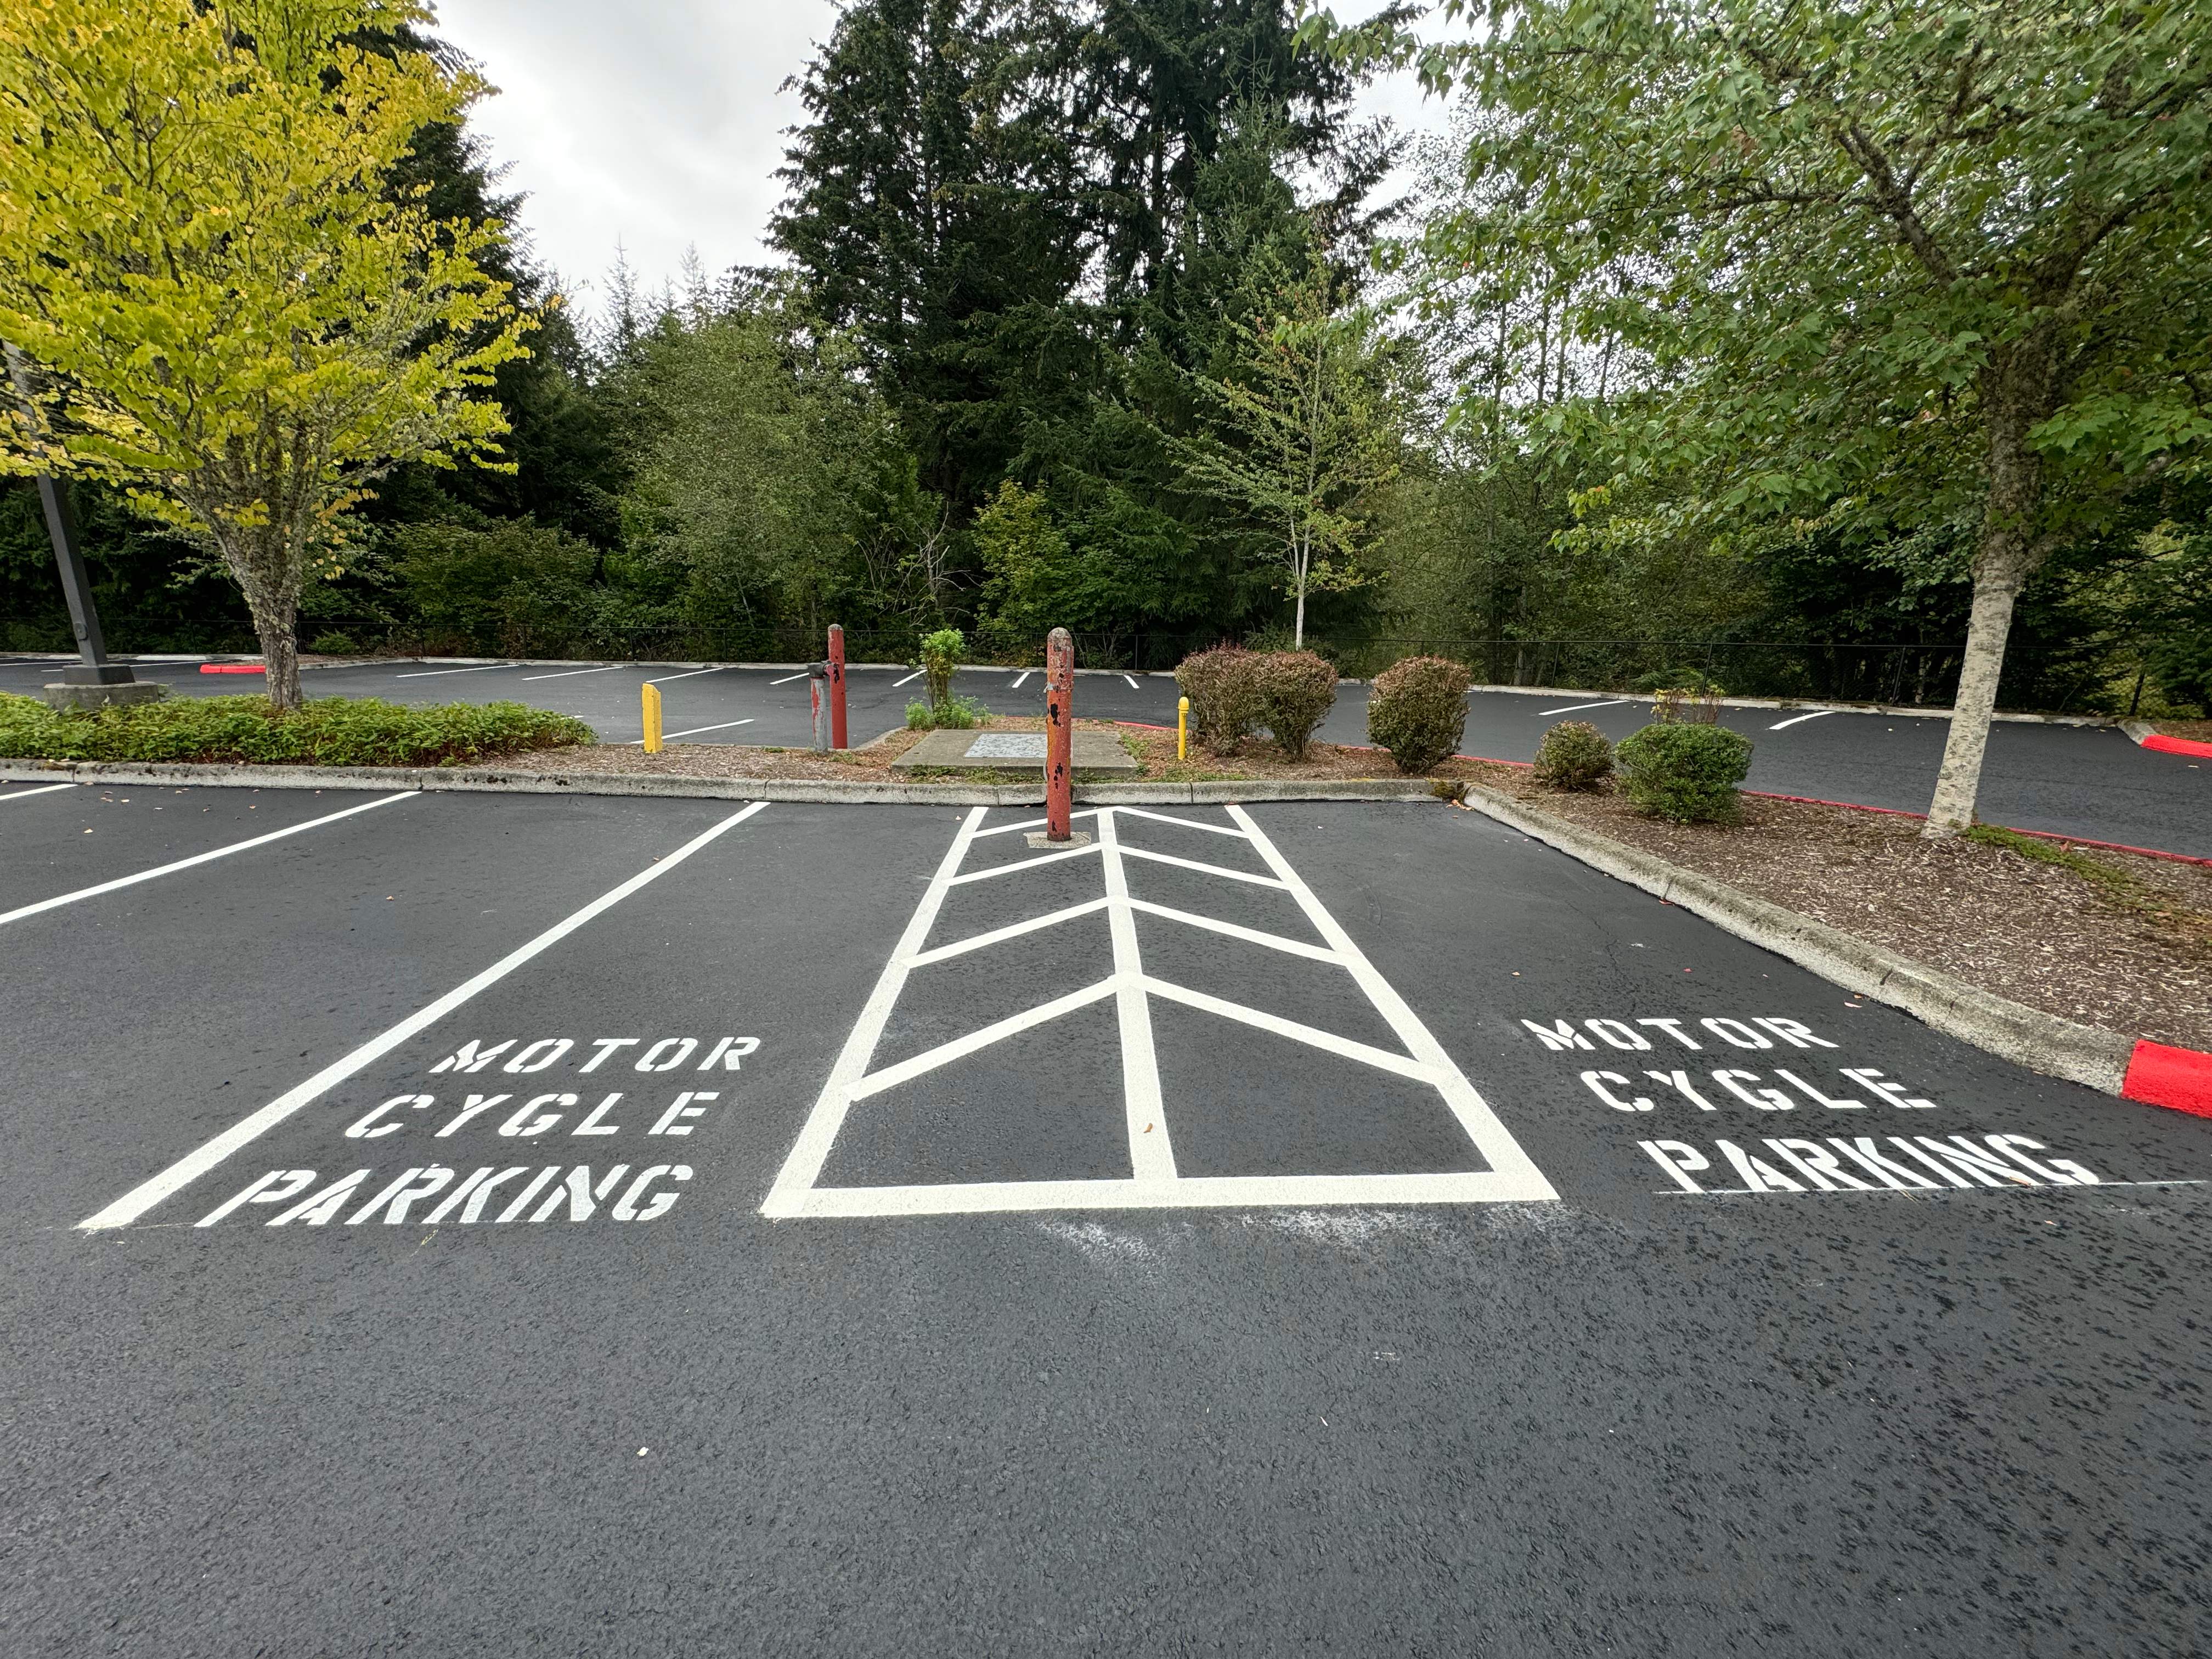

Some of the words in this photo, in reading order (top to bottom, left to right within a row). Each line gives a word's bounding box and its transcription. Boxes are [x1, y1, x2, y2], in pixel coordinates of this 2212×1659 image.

[428, 1036, 761, 1073] MOTOR
[1521, 1017, 1839, 1051] MOTOR
[1637, 1134, 2100, 1196] PARKING
[191, 1164, 694, 1228] PARKING
